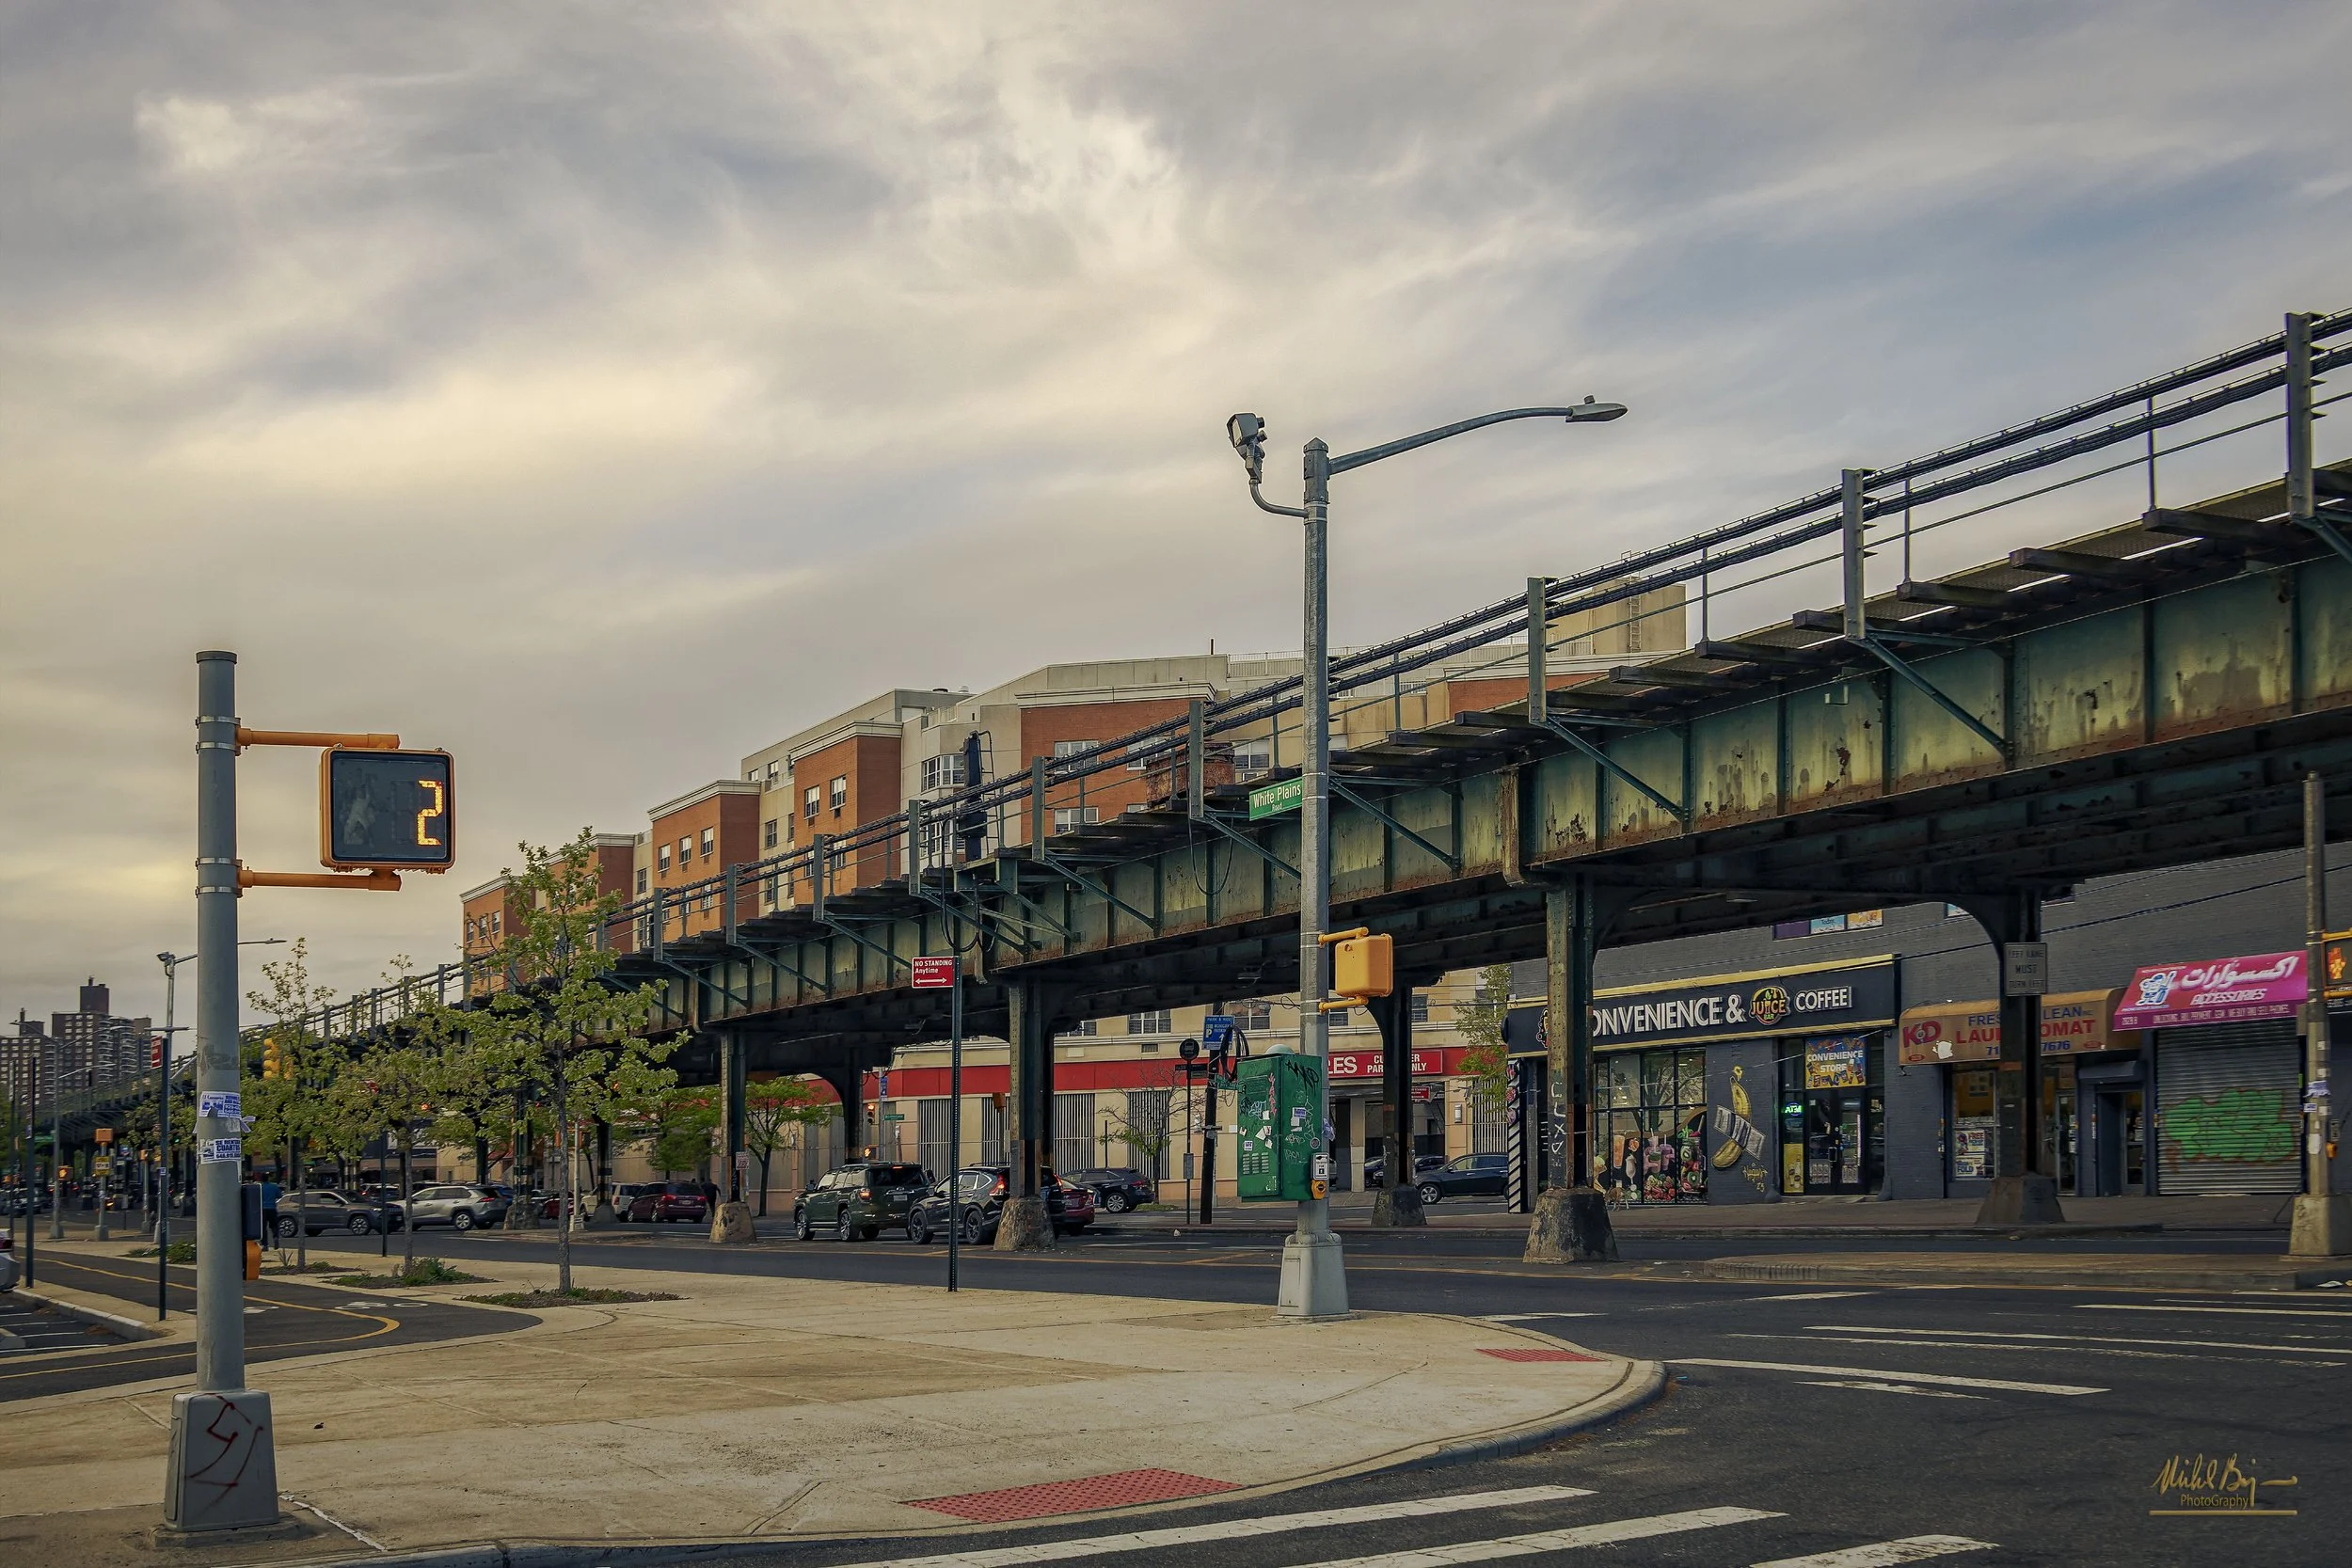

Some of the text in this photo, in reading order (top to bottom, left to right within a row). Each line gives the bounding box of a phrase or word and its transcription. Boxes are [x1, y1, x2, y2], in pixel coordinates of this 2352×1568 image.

[1254, 784, 1301, 808] White Plains
[417, 780, 443, 846] 2
[2015, 964, 2037, 974] MUST
[2190, 988, 2267, 1006] ACCESSORIES
[1593, 997, 1724, 1037] ONVENIENCE
[1726, 994, 1744, 1023] &
[1795, 988, 1848, 1011] COFFEE
[1806, 1050, 1864, 1062] CONVENIENCE
[1412, 1063, 1427, 1071] NLY
[1820, 1063, 1848, 1072] STORE
